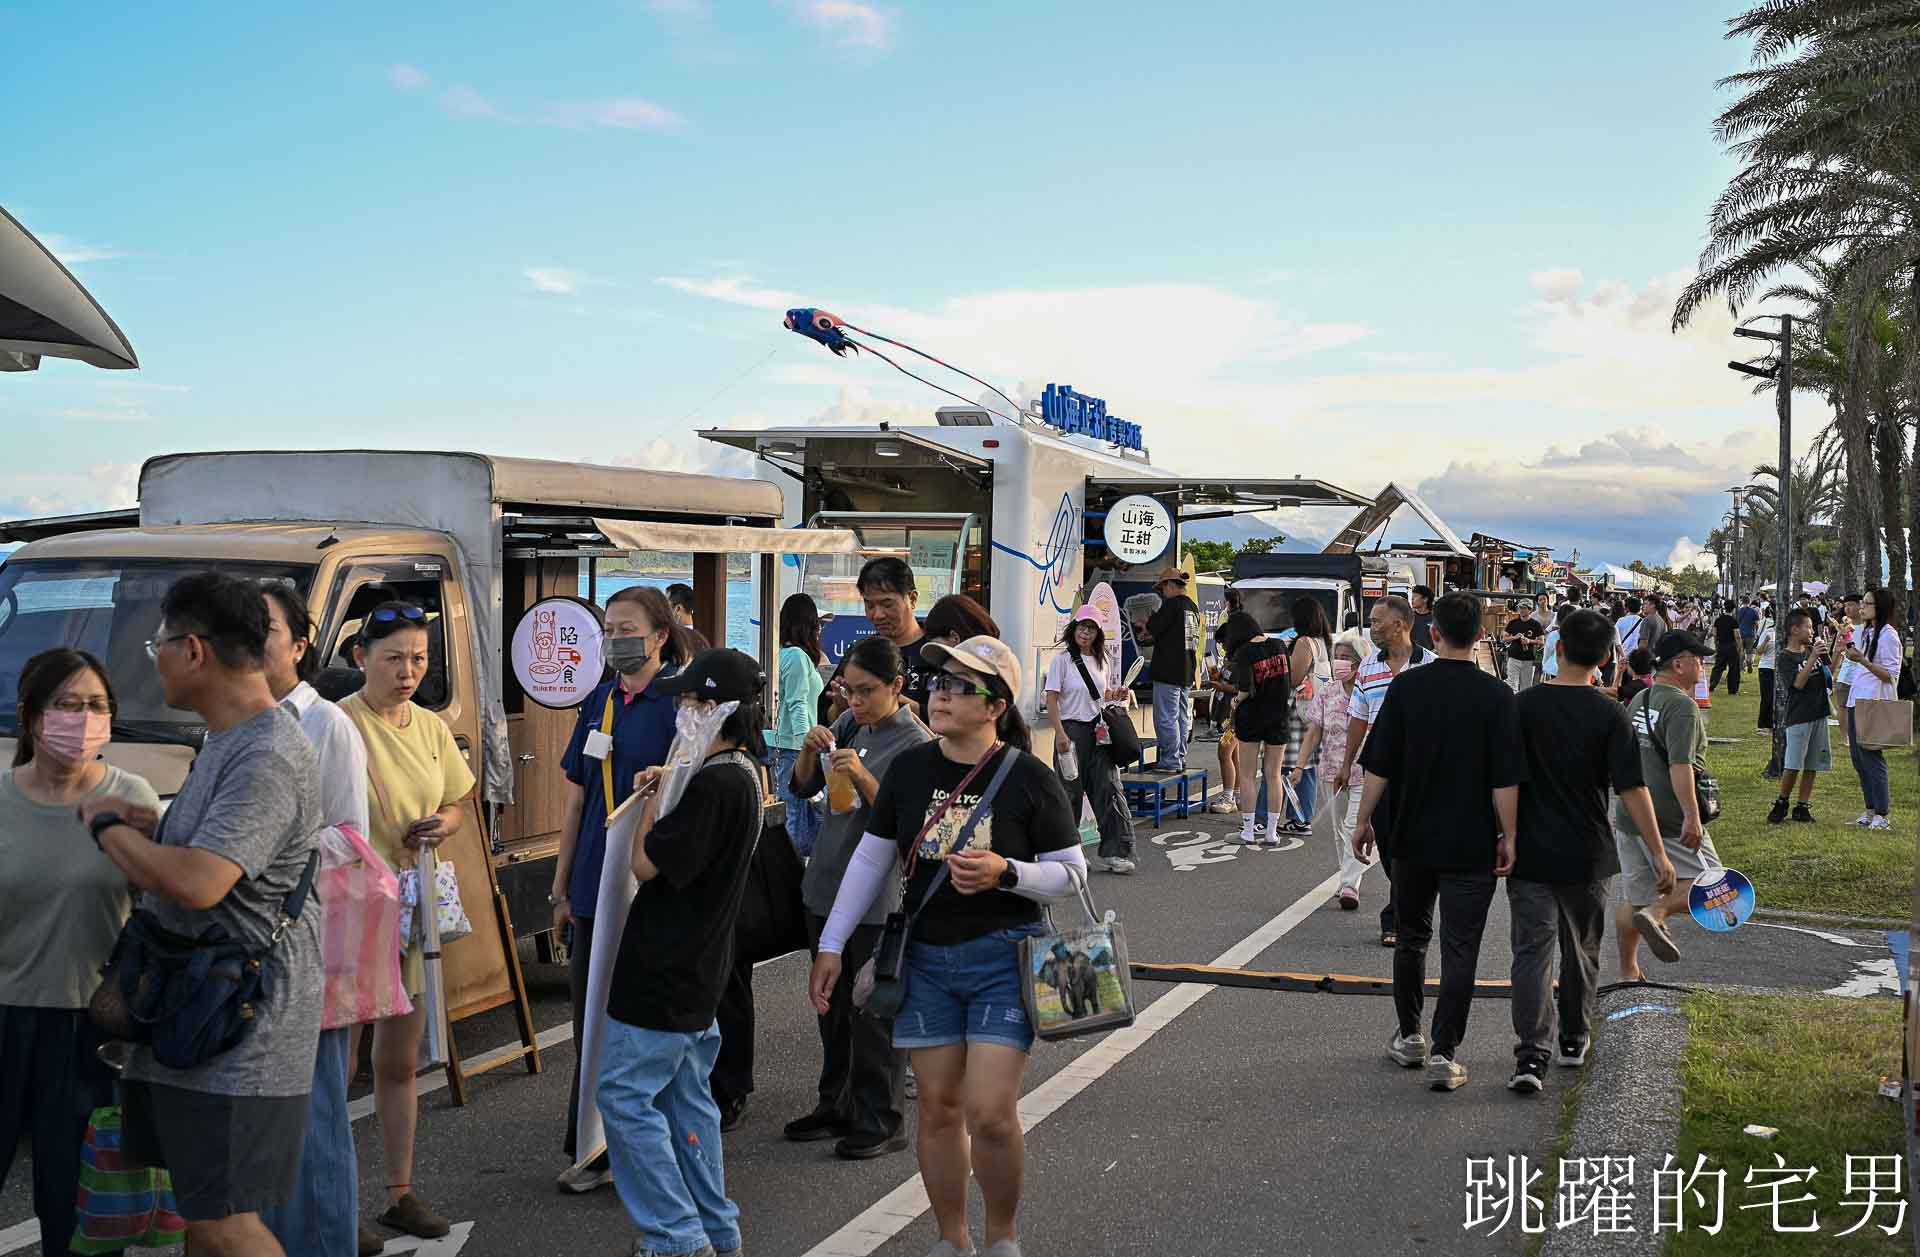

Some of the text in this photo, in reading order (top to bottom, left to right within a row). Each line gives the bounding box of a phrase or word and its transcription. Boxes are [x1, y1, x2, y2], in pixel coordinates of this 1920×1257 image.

[1122, 510, 1155, 527] 山海
[1120, 529, 1152, 546] 正甜
[1551, 567, 1568, 578] IZZA
